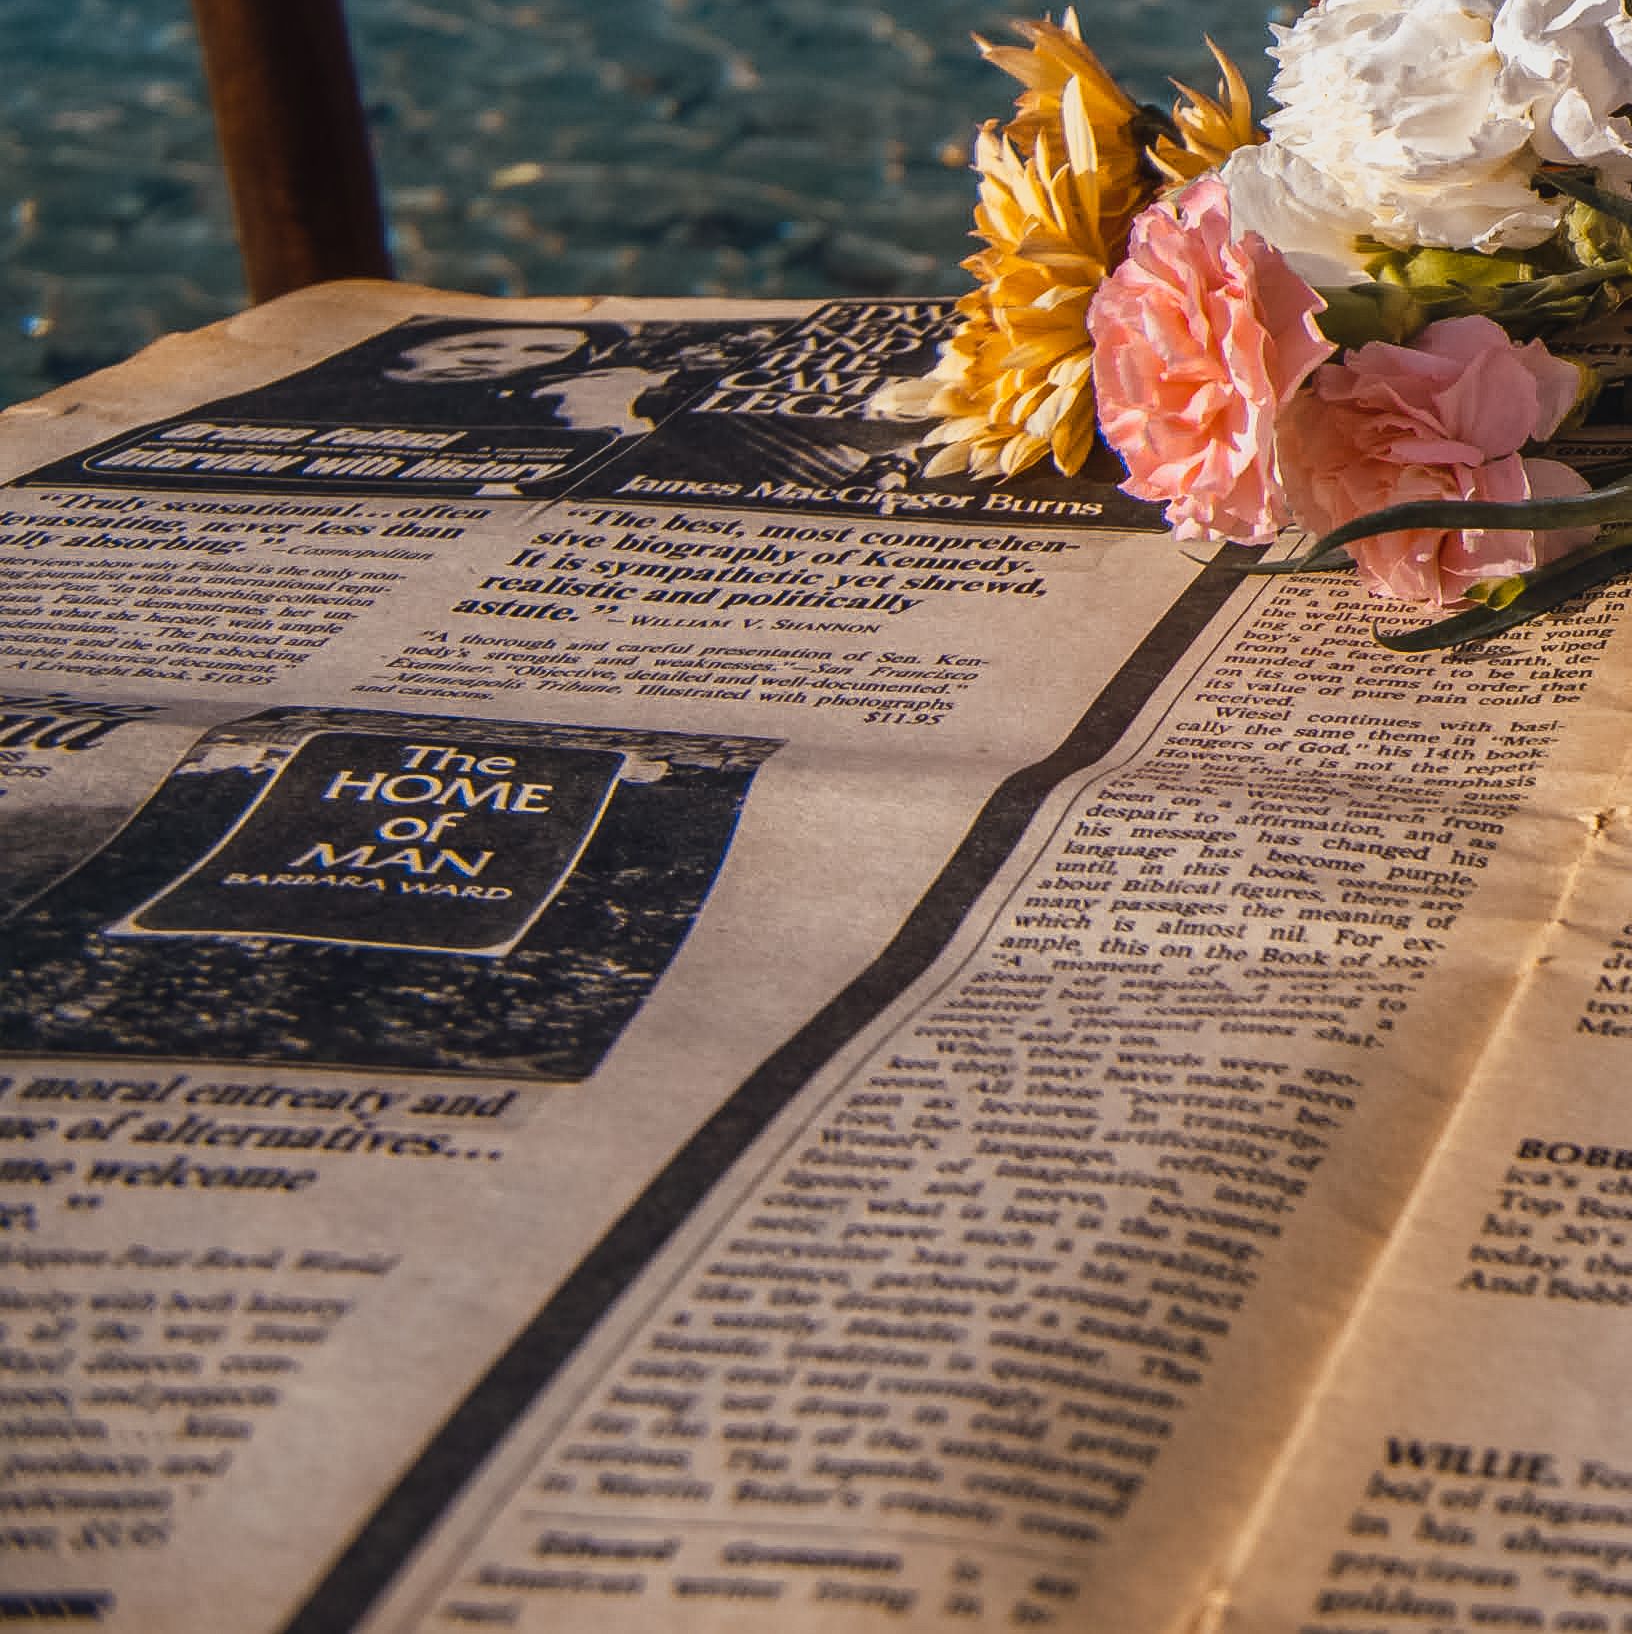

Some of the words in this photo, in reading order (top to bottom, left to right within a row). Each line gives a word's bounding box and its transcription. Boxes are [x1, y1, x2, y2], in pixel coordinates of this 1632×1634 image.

[398, 504, 492, 519] often
[615, 475, 742, 500] James
[980, 493, 1103, 518] Burns
[530, 529, 605, 549] sive
[611, 530, 801, 568] biography
[807, 542, 859, 569] of
[868, 549, 1036, 575] Kennedy.
[670, 513, 745, 541] best,
[759, 523, 857, 543] most
[862, 528, 1082, 557] comprehen-
[505, 550, 549, 569] It
[554, 551, 583, 573] is
[587, 556, 822, 592] sympathetic
[829, 569, 894, 591] yet
[899, 575, 1049, 599] shrewd,
[476, 573, 640, 603] realistic
[645, 584, 713, 608] and
[718, 586, 926, 616] politically
[863, 711, 944, 726] $11.95
[1214, 706, 1292, 722] Wiesel
[1307, 711, 1421, 729] continues
[1441, 718, 1493, 733] with
[1510, 720, 1564, 733] basi-
[400, 744, 518, 774] The
[322, 771, 553, 814] HOME
[375, 812, 469, 845] of
[288, 843, 495, 878] MAN
[222, 872, 386, 892] BARBARA
[400, 882, 514, 902] WARD
